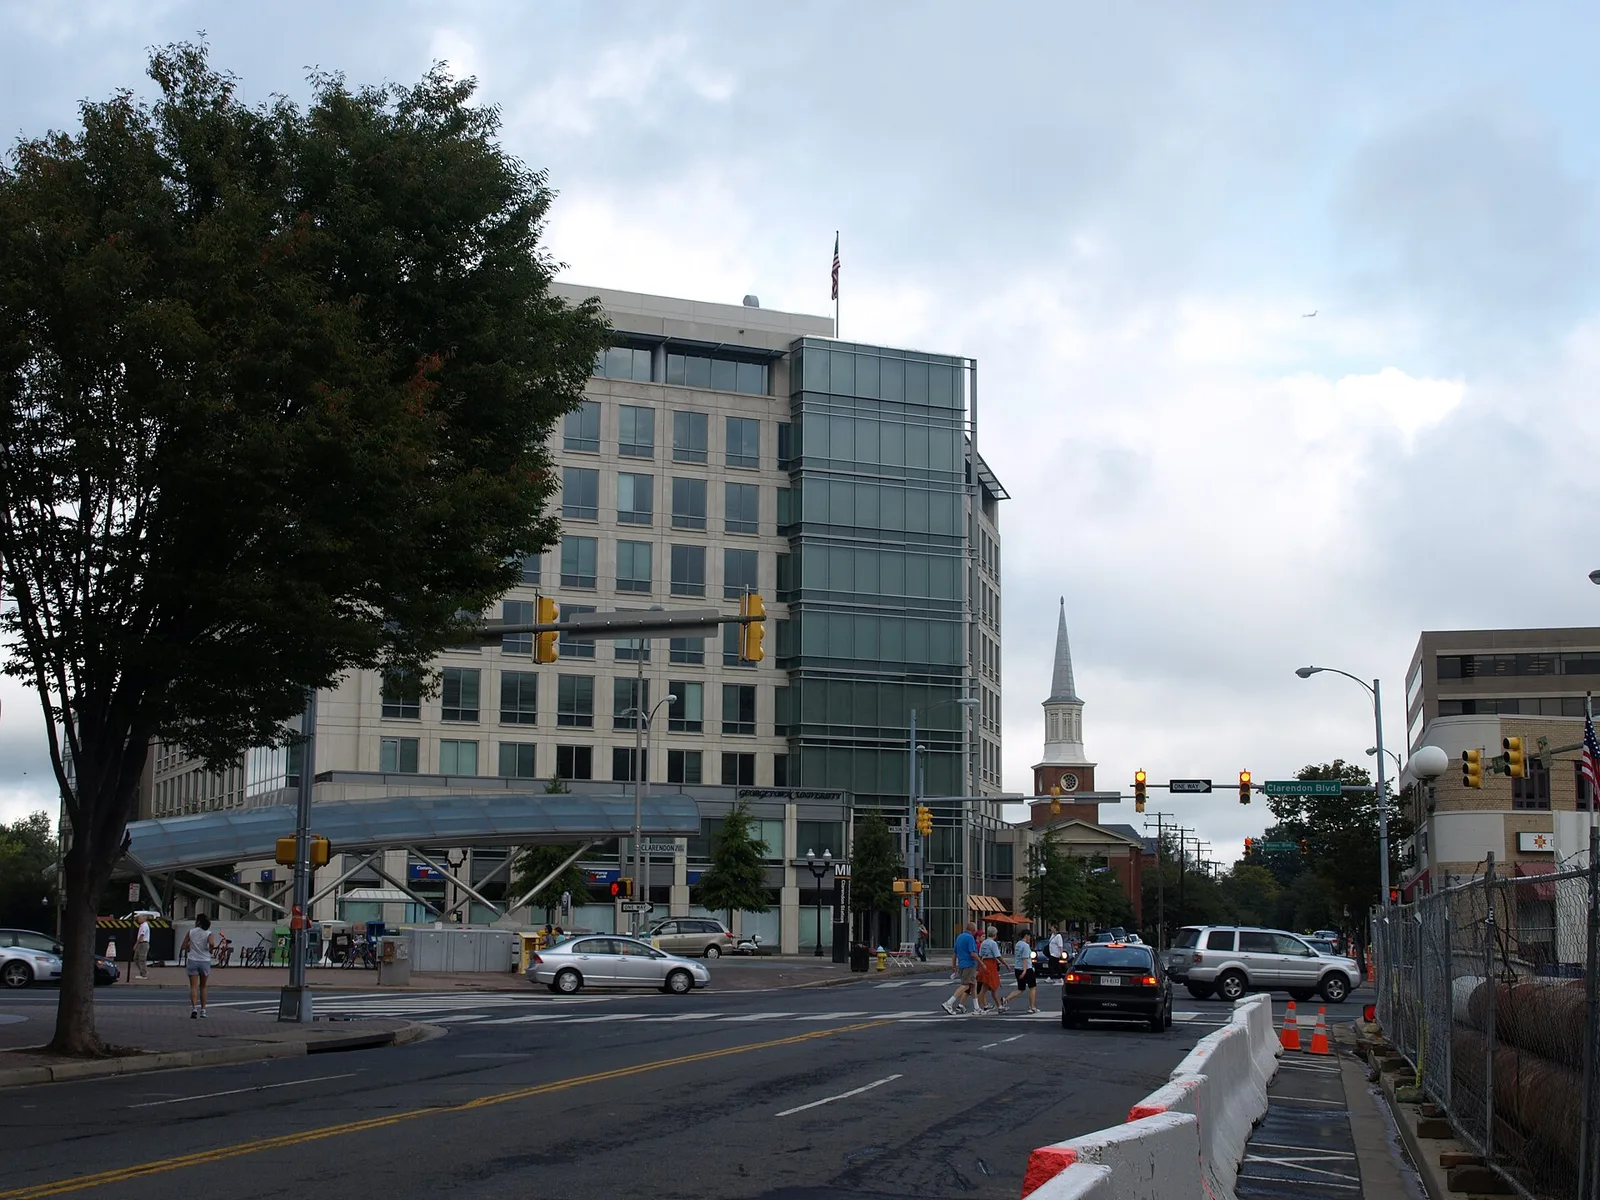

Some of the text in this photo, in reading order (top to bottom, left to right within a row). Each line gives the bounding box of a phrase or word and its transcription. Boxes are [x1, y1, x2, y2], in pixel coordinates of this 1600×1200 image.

[1266, 784, 1339, 792] Clarendon Blvd.
[739, 789, 842, 799] GEORGETOWN UNIVERSITY
[641, 843, 675, 852] CLARENDON
[835, 864, 846, 876] M
